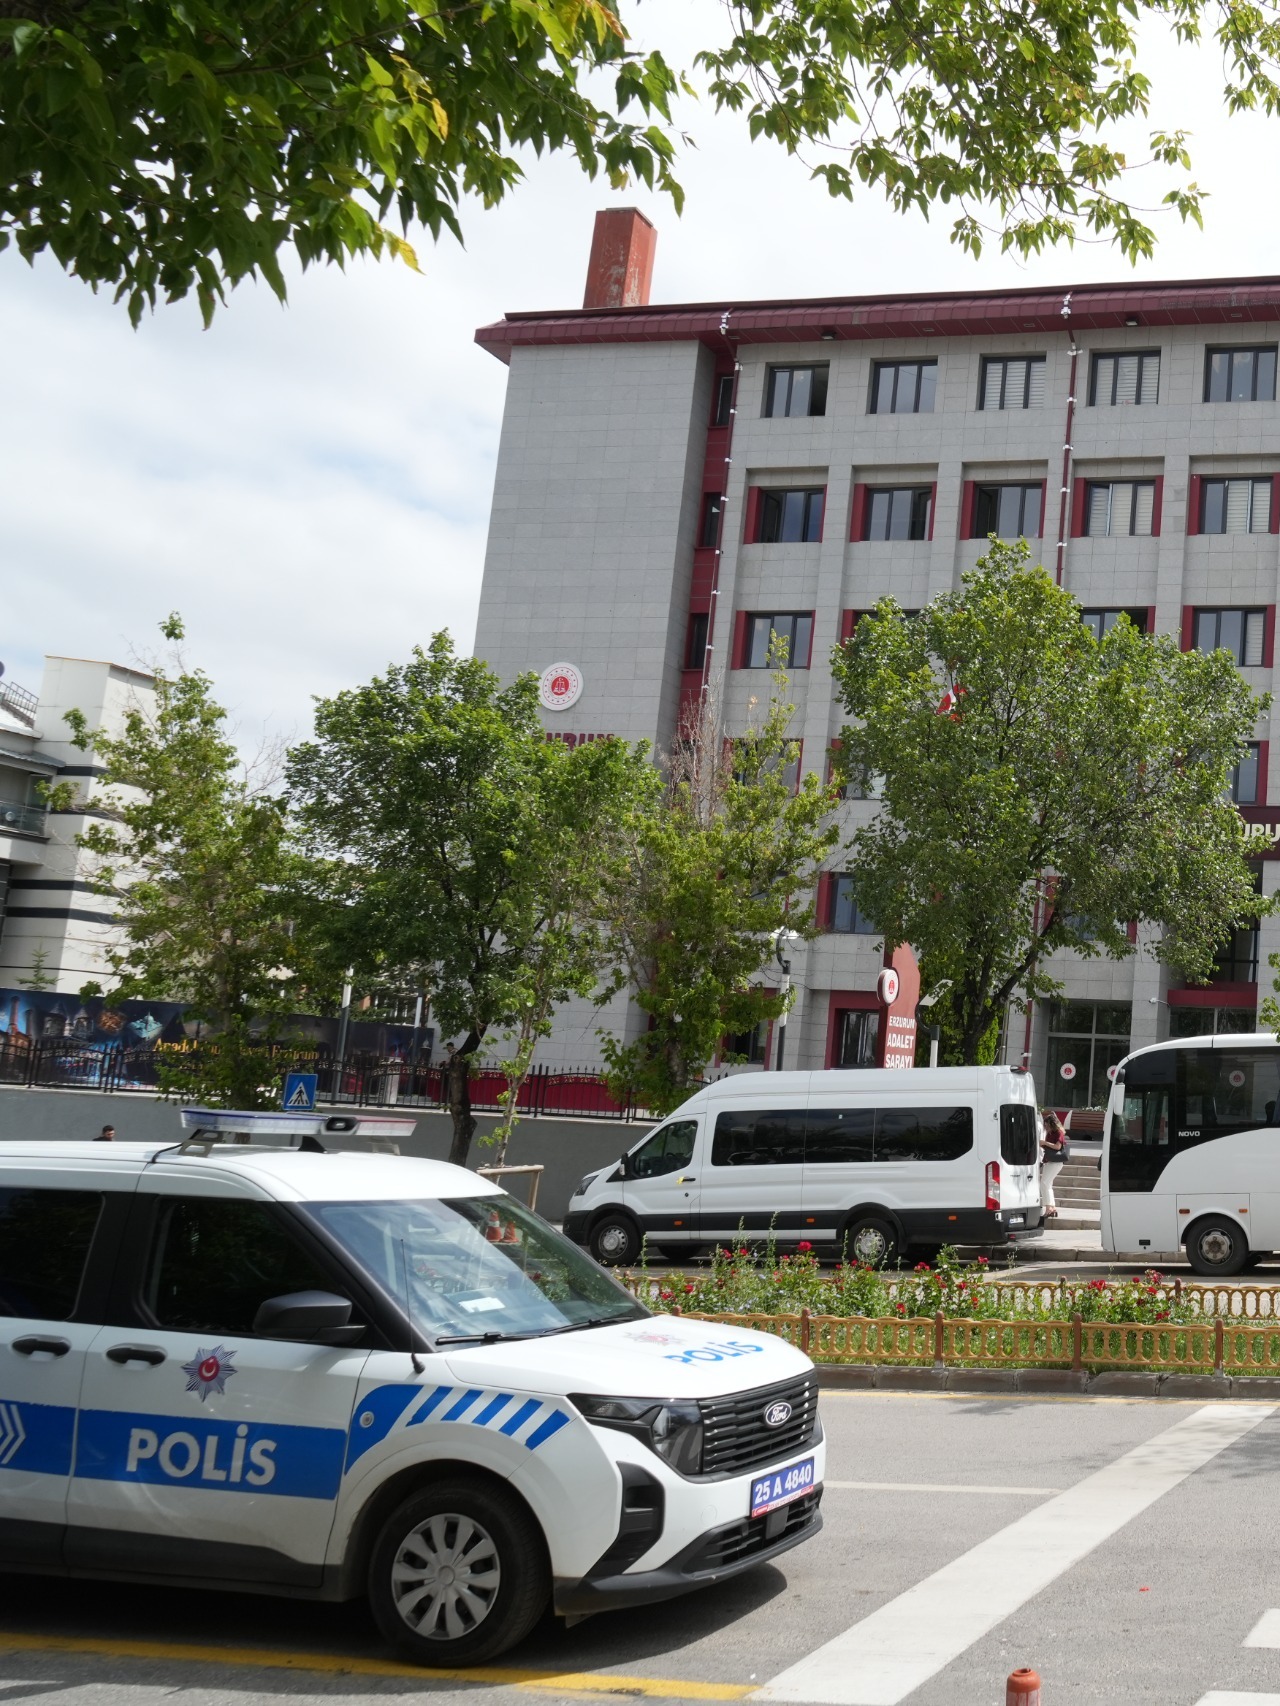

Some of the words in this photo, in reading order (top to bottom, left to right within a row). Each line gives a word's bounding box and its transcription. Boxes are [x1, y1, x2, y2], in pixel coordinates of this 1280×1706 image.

[889, 1015, 915, 1028] ERZURUM
[887, 1033, 914, 1048] ADALET
[885, 1054, 913, 1069] SARAYI
[770, 1405, 788, 1422] Ford
[126, 1424, 278, 1486] POLİS
[755, 1480, 771, 1504] 25
[772, 1476, 783, 1498] A
[784, 1464, 812, 1491] 4840
